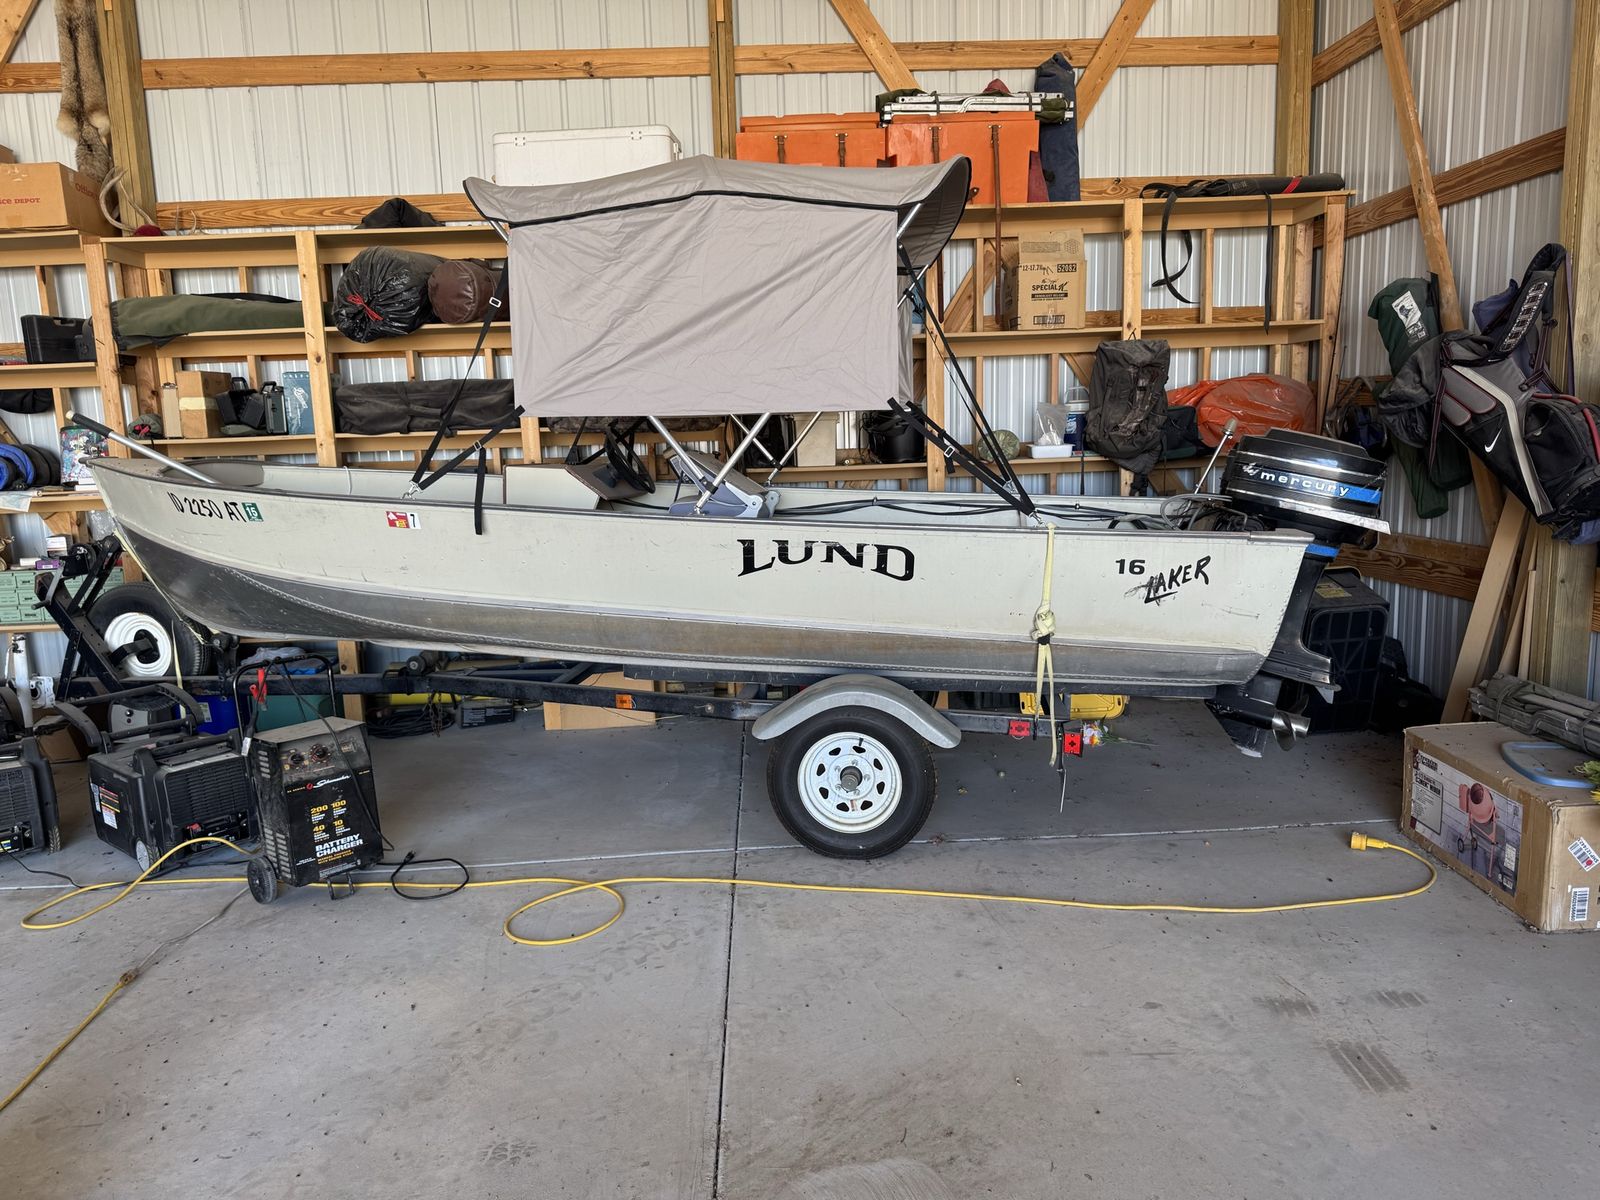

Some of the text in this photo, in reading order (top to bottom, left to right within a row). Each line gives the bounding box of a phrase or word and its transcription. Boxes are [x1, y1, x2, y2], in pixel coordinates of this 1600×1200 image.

[1031, 284, 1058, 292] SPECIAL
[1260, 471, 1349, 497] mercury
[167, 491, 247, 522] ID 2250 AT
[245, 506, 258, 518] 15
[737, 539, 915, 581] LUND
[1115, 555, 1211, 604] 16 LAKER
[310, 804, 328, 814] 200
[331, 800, 347, 808] 100
[313, 824, 326, 832] 40
[333, 819, 344, 827] 10
[315, 833, 360, 852] BATTERY
[316, 839, 364, 858] CHARGER
